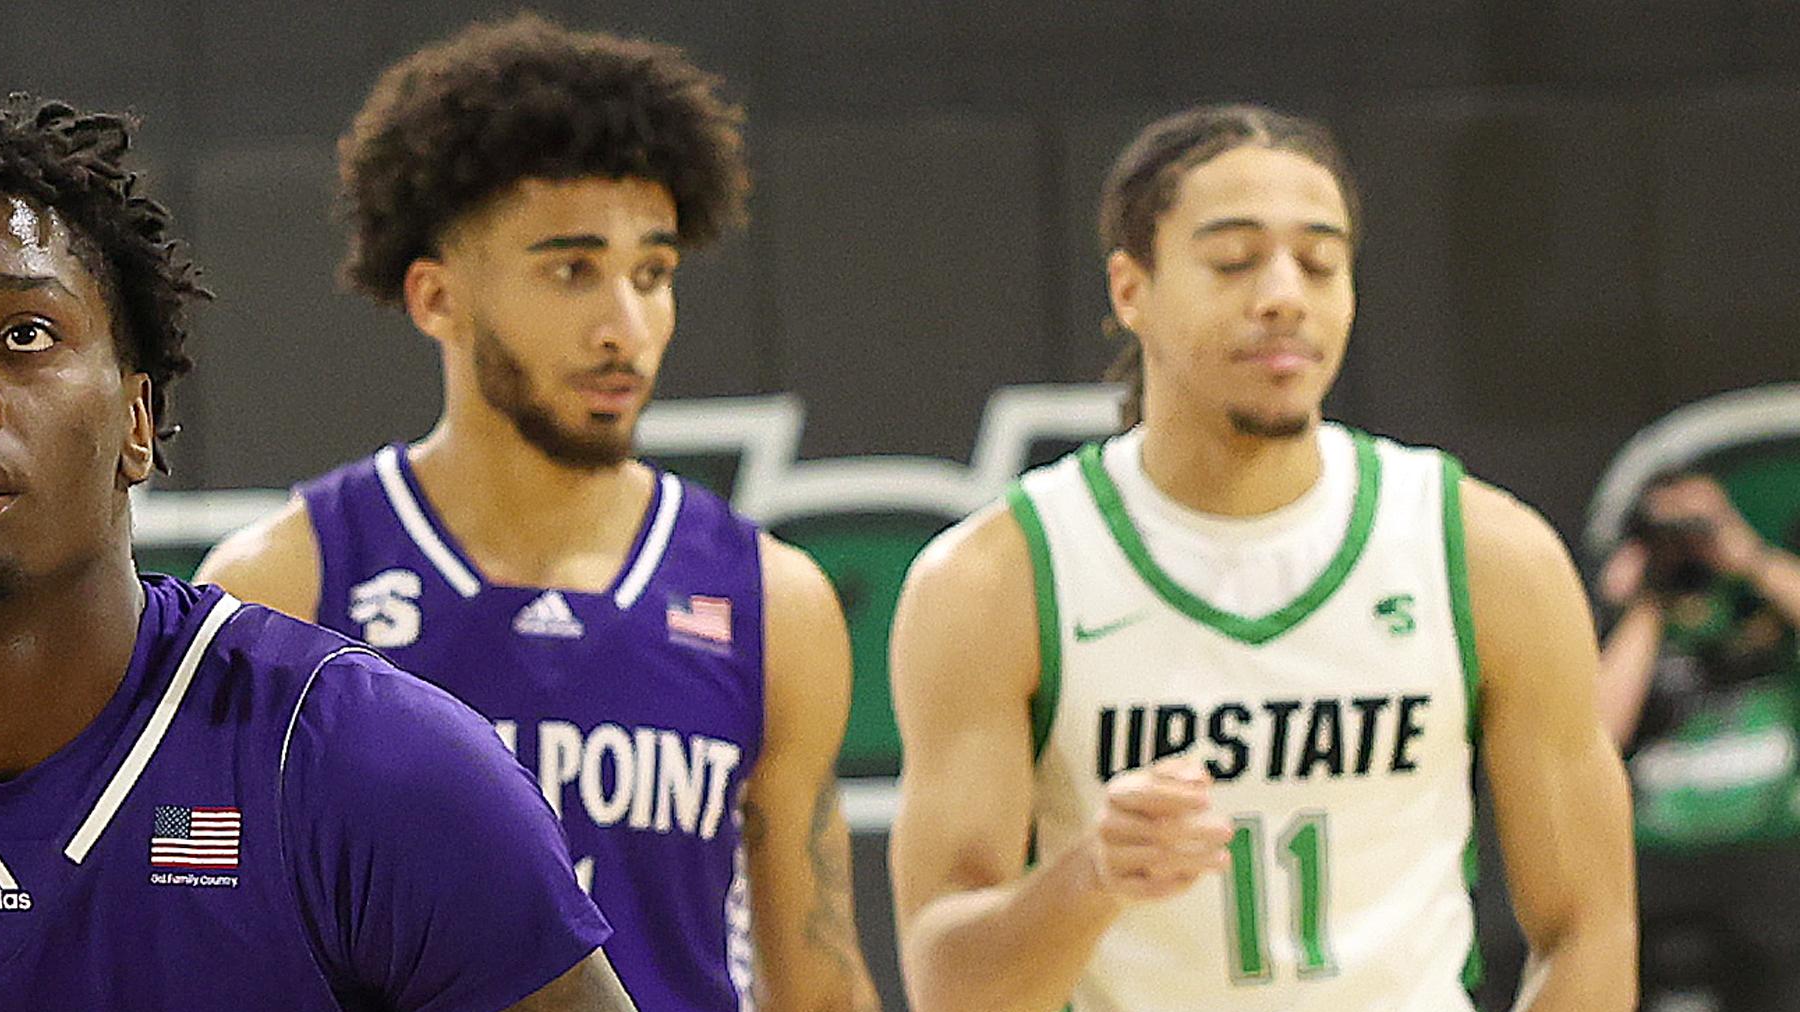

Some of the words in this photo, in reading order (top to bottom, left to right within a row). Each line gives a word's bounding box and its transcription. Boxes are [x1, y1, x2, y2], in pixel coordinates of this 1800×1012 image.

[537, 719, 741, 840] POINT
[1096, 694, 1432, 783] UPSTATE
[1224, 809, 1340, 986] 11
